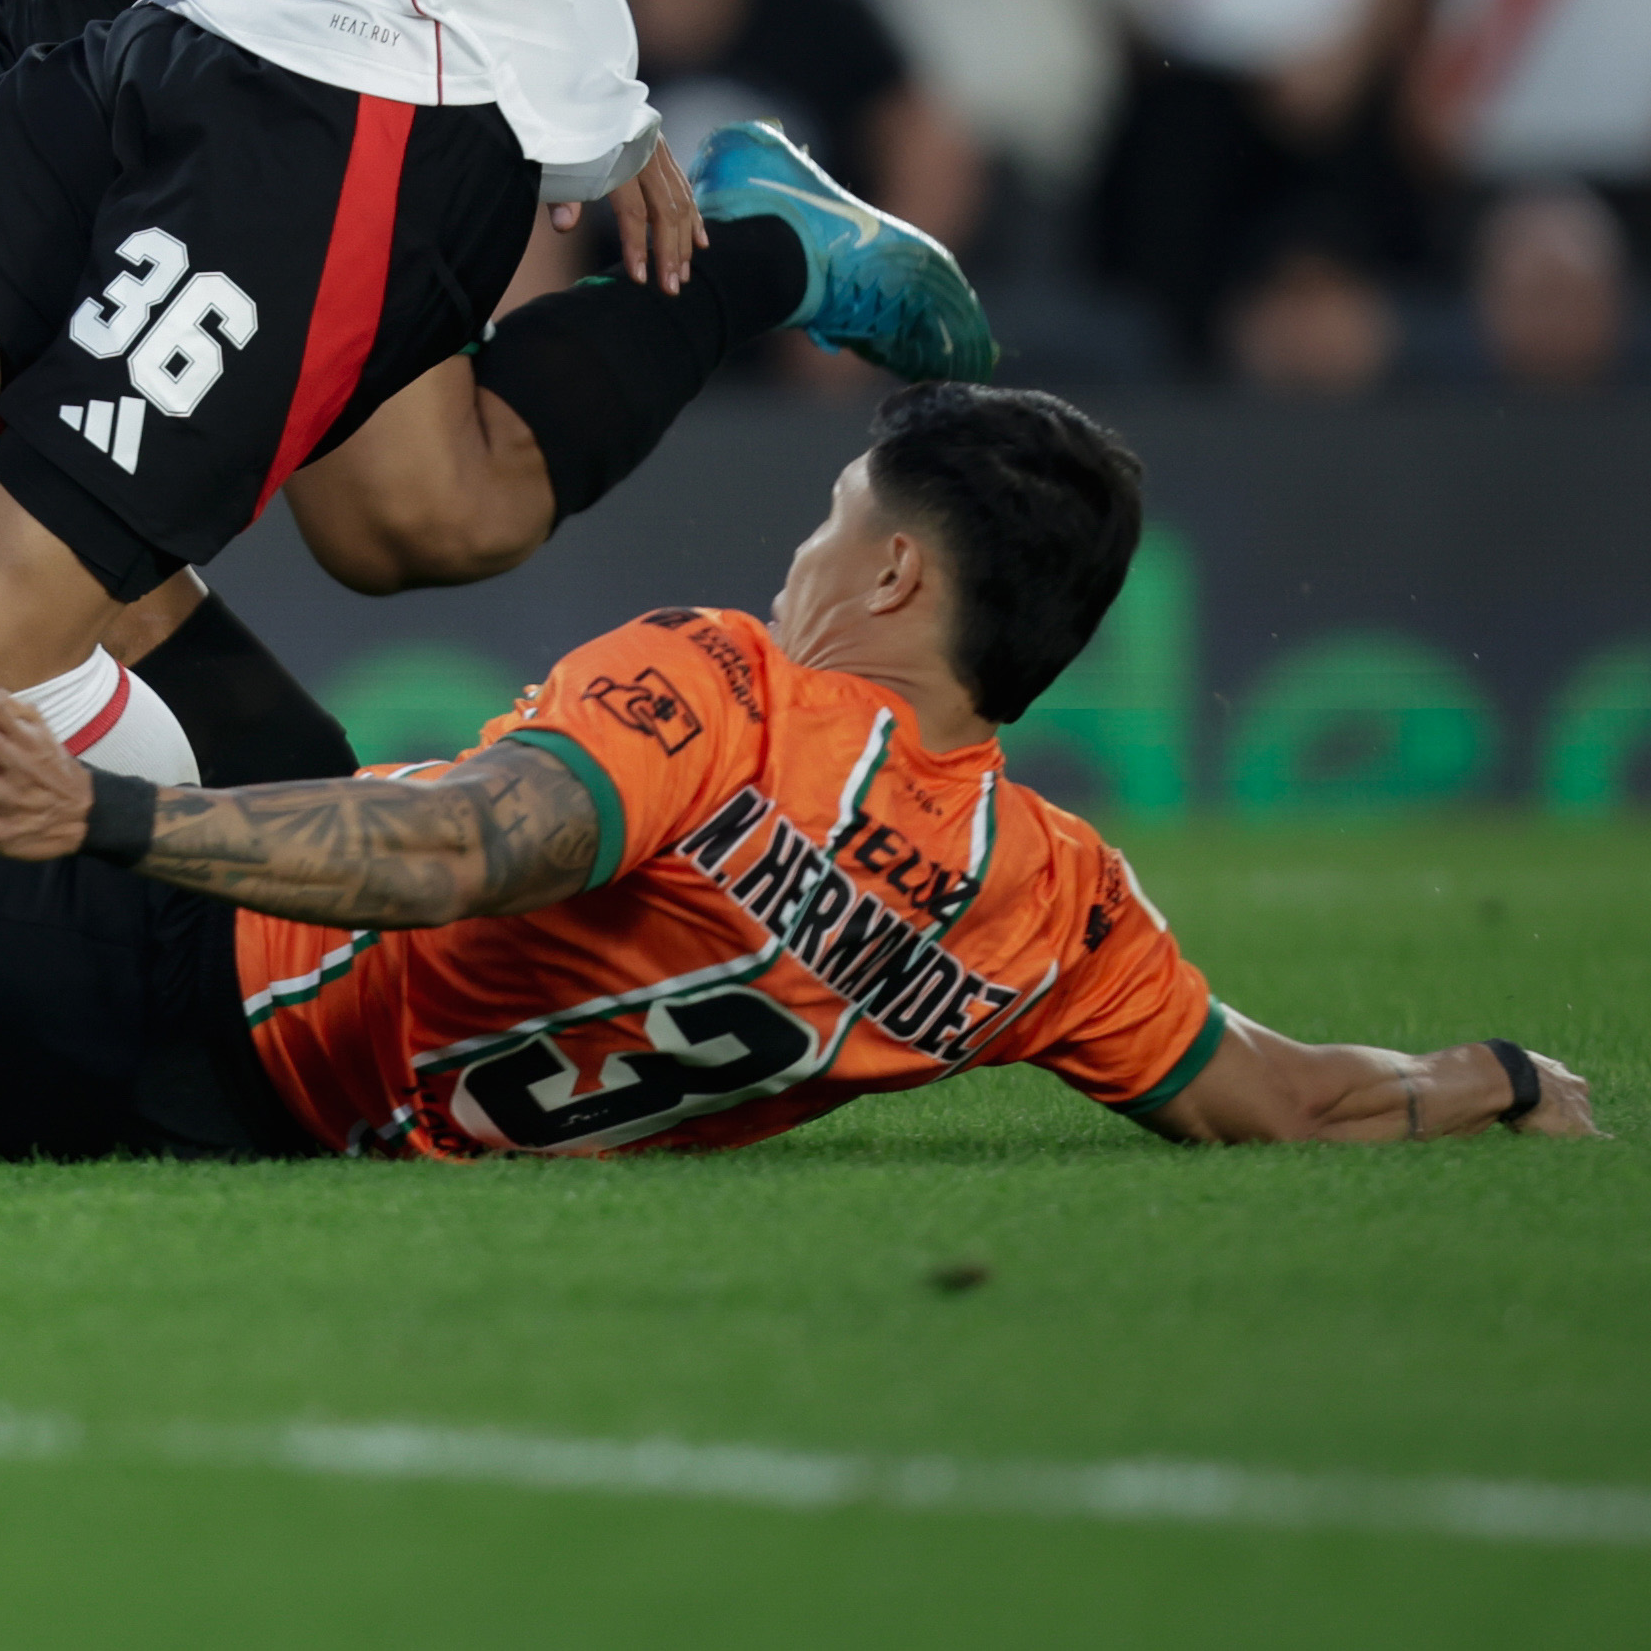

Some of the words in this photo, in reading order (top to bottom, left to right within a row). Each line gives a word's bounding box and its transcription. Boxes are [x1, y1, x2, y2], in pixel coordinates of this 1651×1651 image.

[329, 13, 402, 47] HEAT.RDY
[69, 226, 259, 418] 36
[451, 983, 819, 1151] 3
